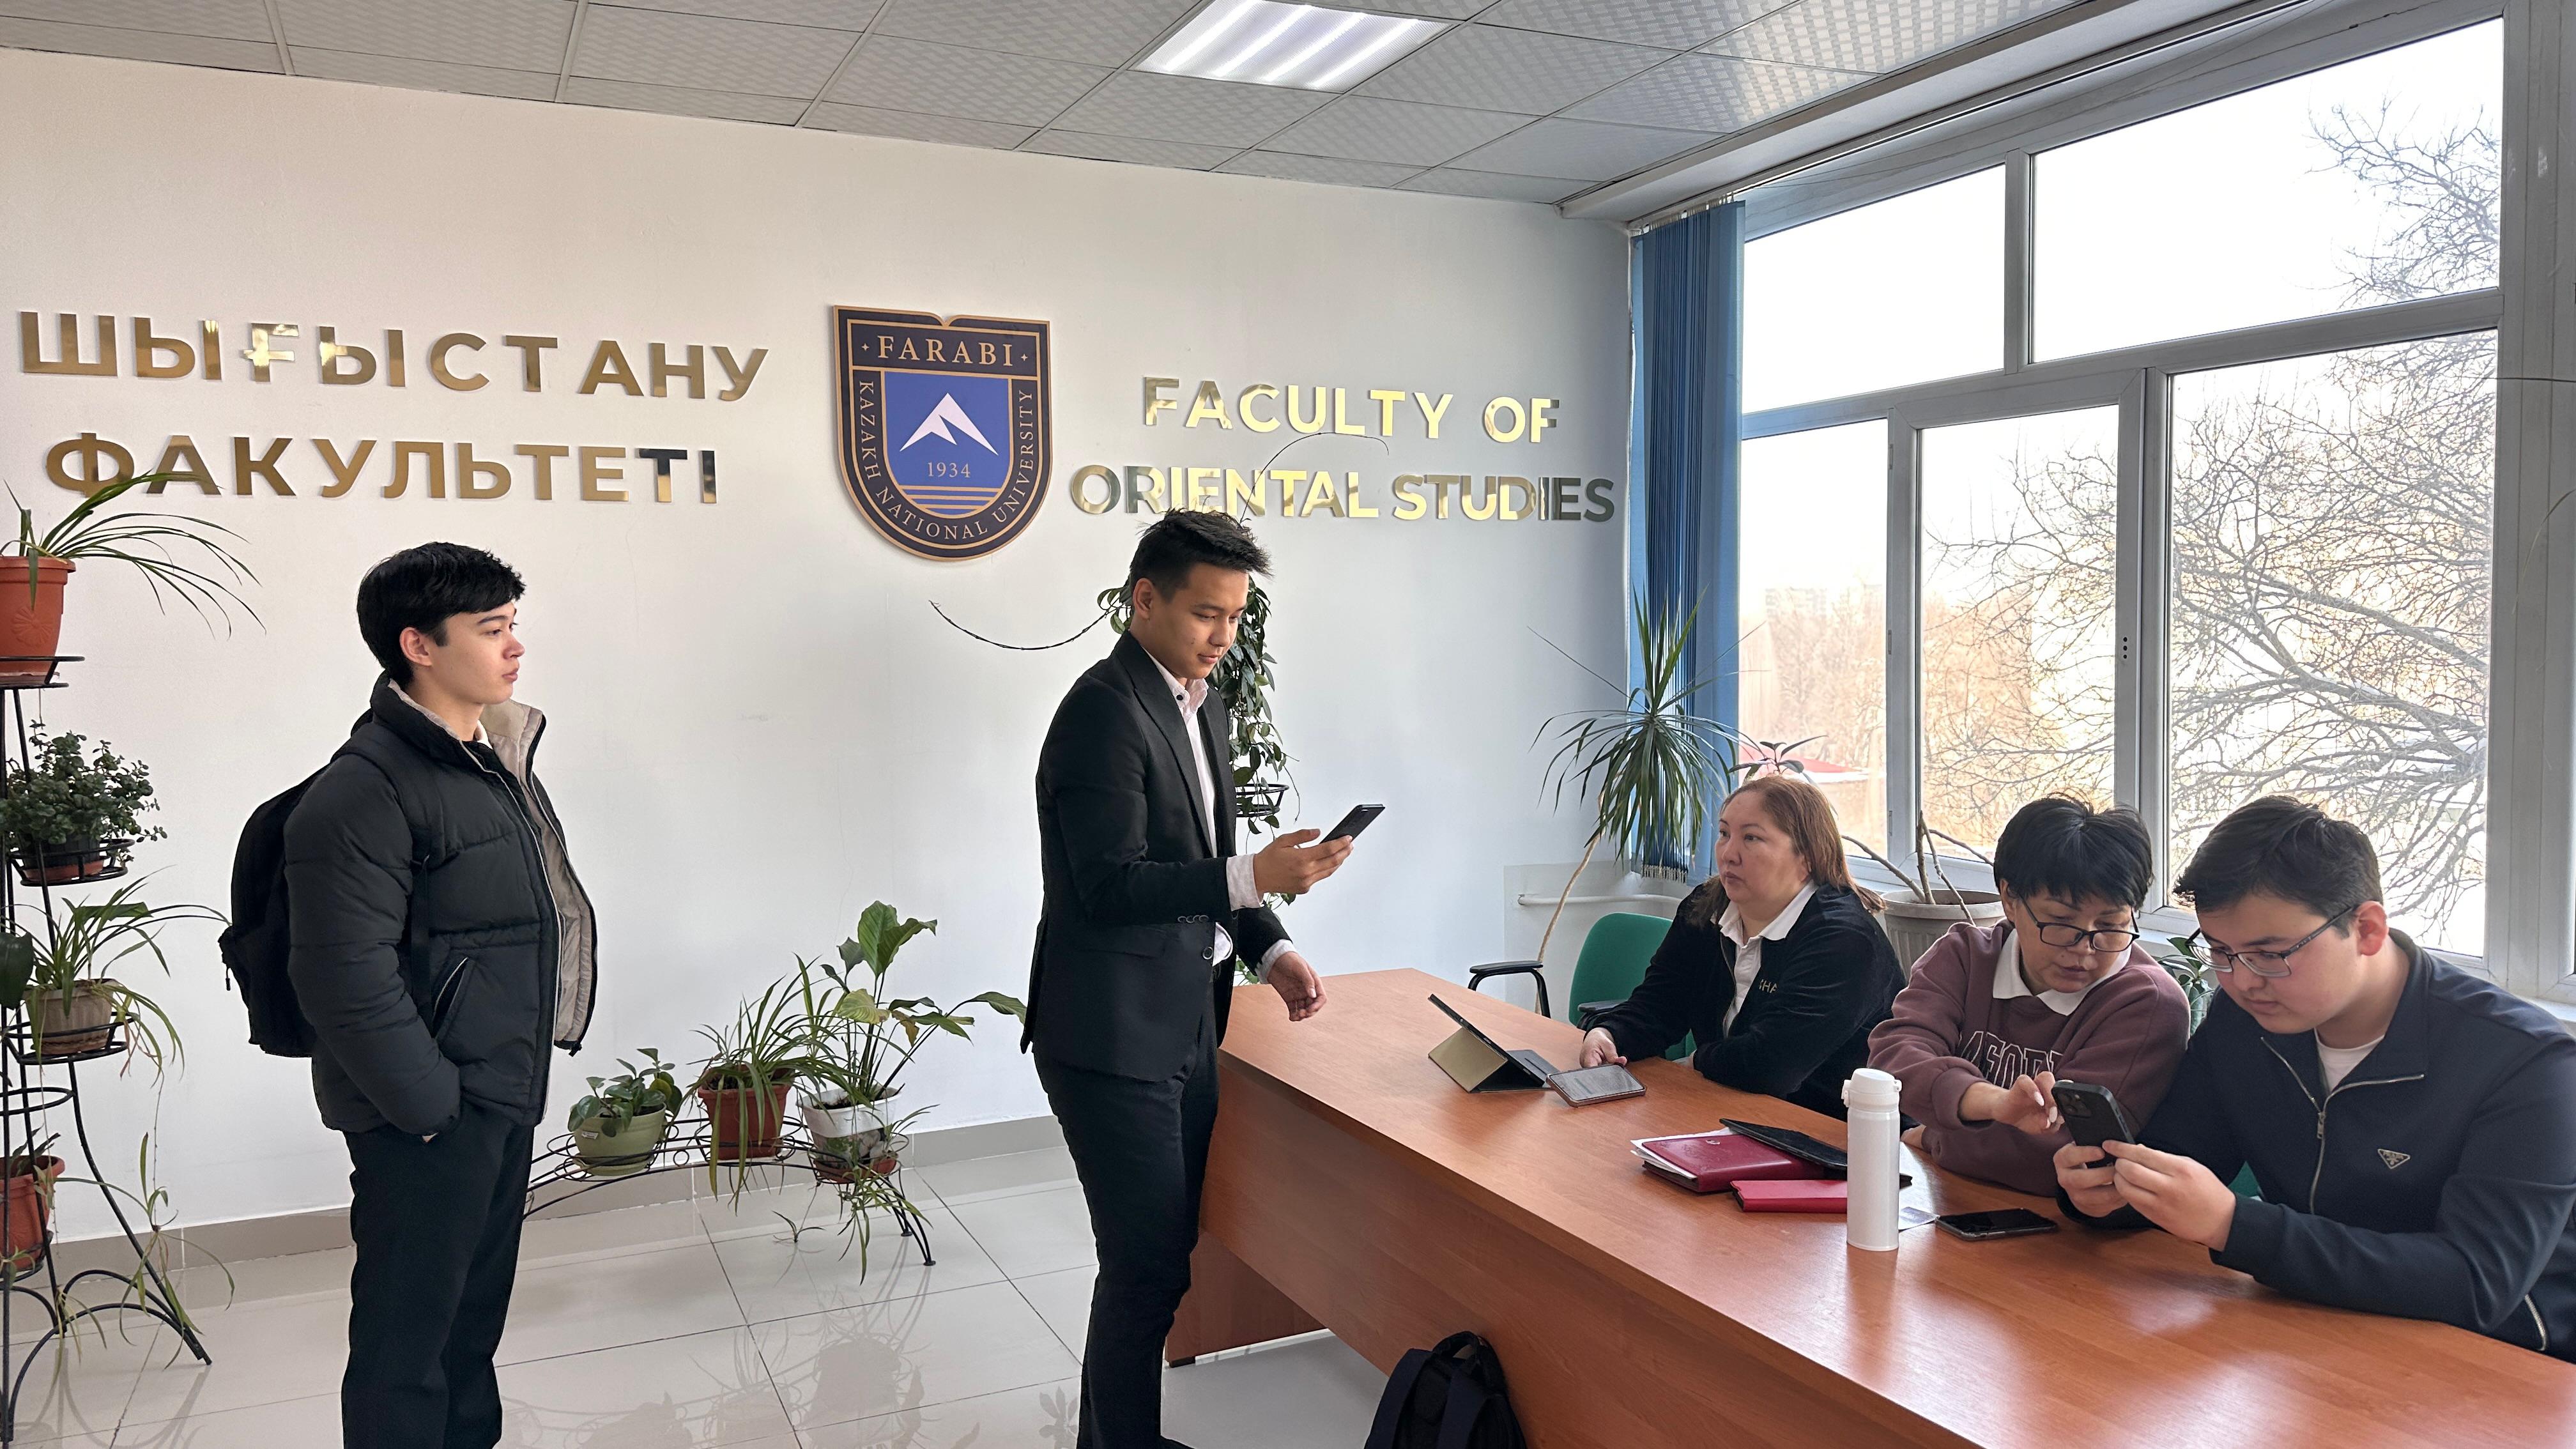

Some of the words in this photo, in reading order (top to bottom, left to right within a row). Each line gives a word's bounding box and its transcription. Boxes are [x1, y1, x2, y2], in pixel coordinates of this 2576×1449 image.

[20, 311, 769, 401] ШЫҒЫСТАНУ
[877, 335, 1013, 366] FARABI
[1144, 376, 1453, 439] FACULTY
[1484, 395, 1560, 443] OF
[46, 432, 717, 503] ФАКУЛЬТЕТІ
[859, 380, 881, 480] KAZAKH
[876, 486, 988, 540] NATIONAL
[992, 389, 1033, 523] UNIVERSITY
[927, 461, 971, 479] 1934
[1070, 464, 1379, 519] ORIENTAL
[1393, 473, 1615, 522] STUDIES
